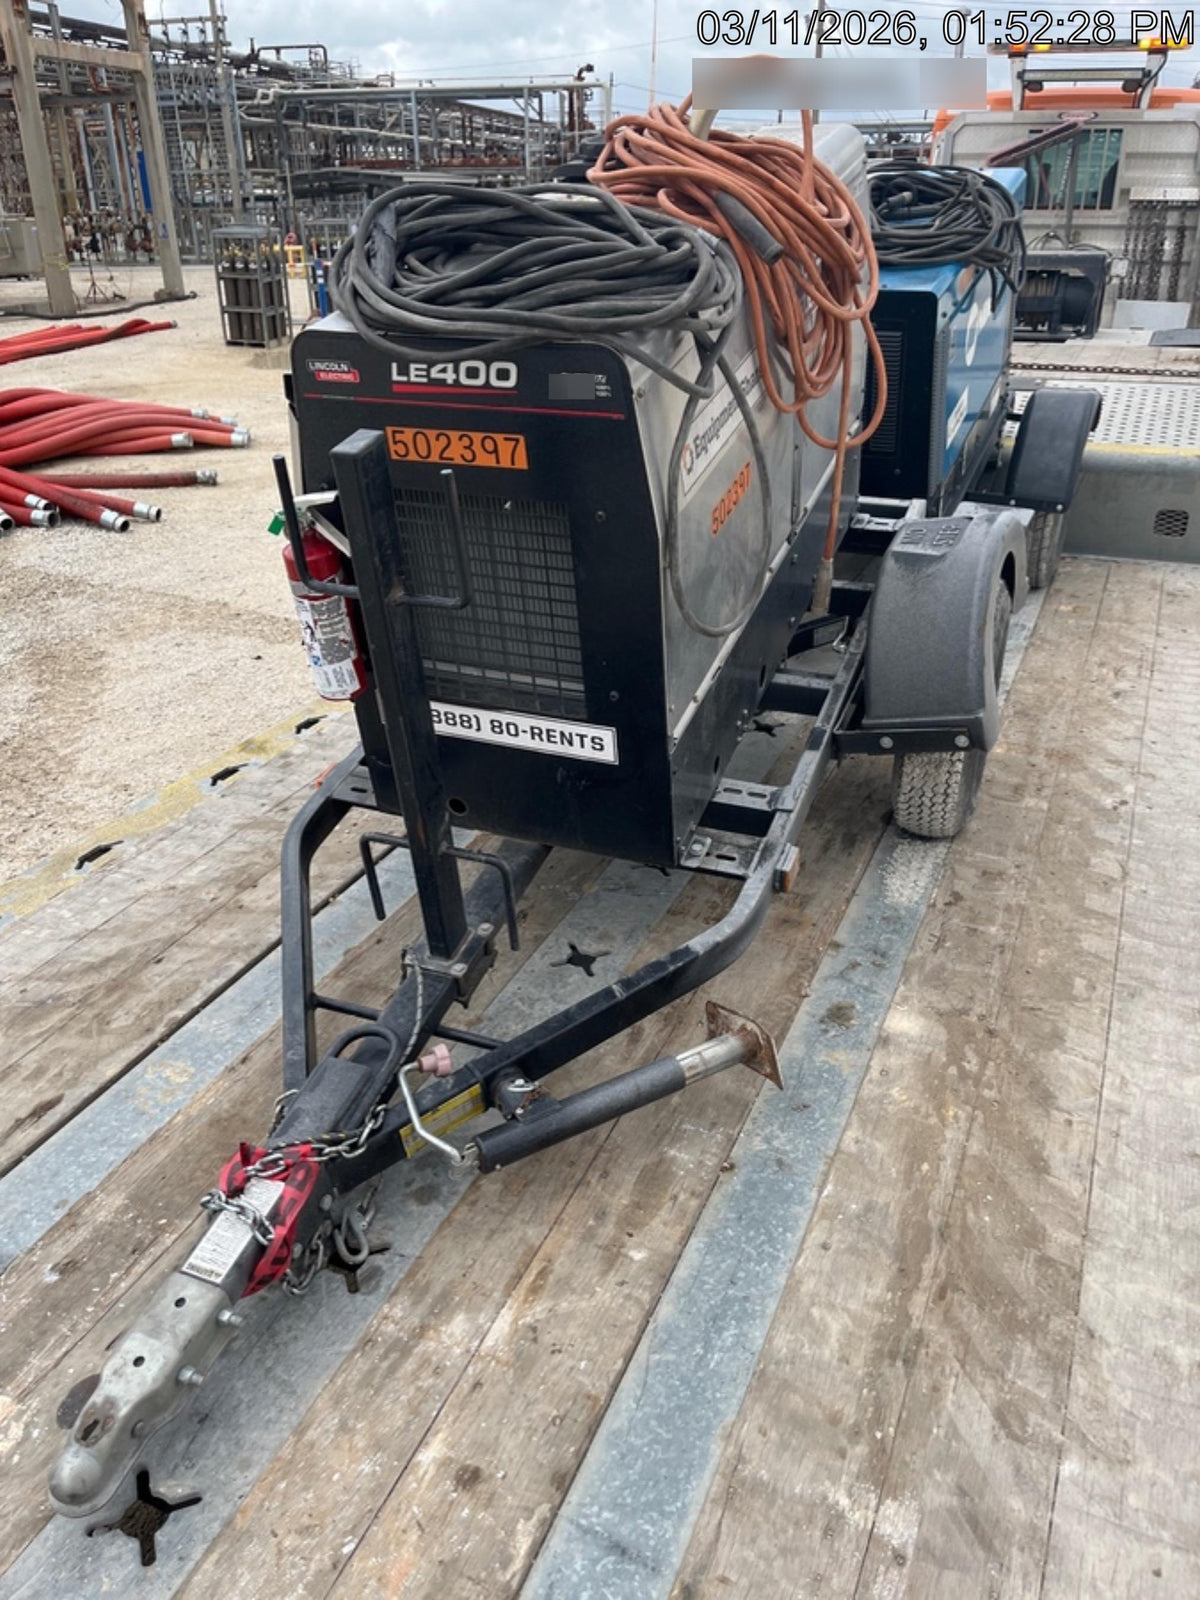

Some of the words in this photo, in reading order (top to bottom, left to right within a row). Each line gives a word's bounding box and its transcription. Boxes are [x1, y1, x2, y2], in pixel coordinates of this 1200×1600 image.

[308, 361, 349, 372] LINCOLN
[390, 360, 518, 388] LE400
[391, 429, 521, 467] 502397
[490, 718, 606, 753] 80-RENTS
